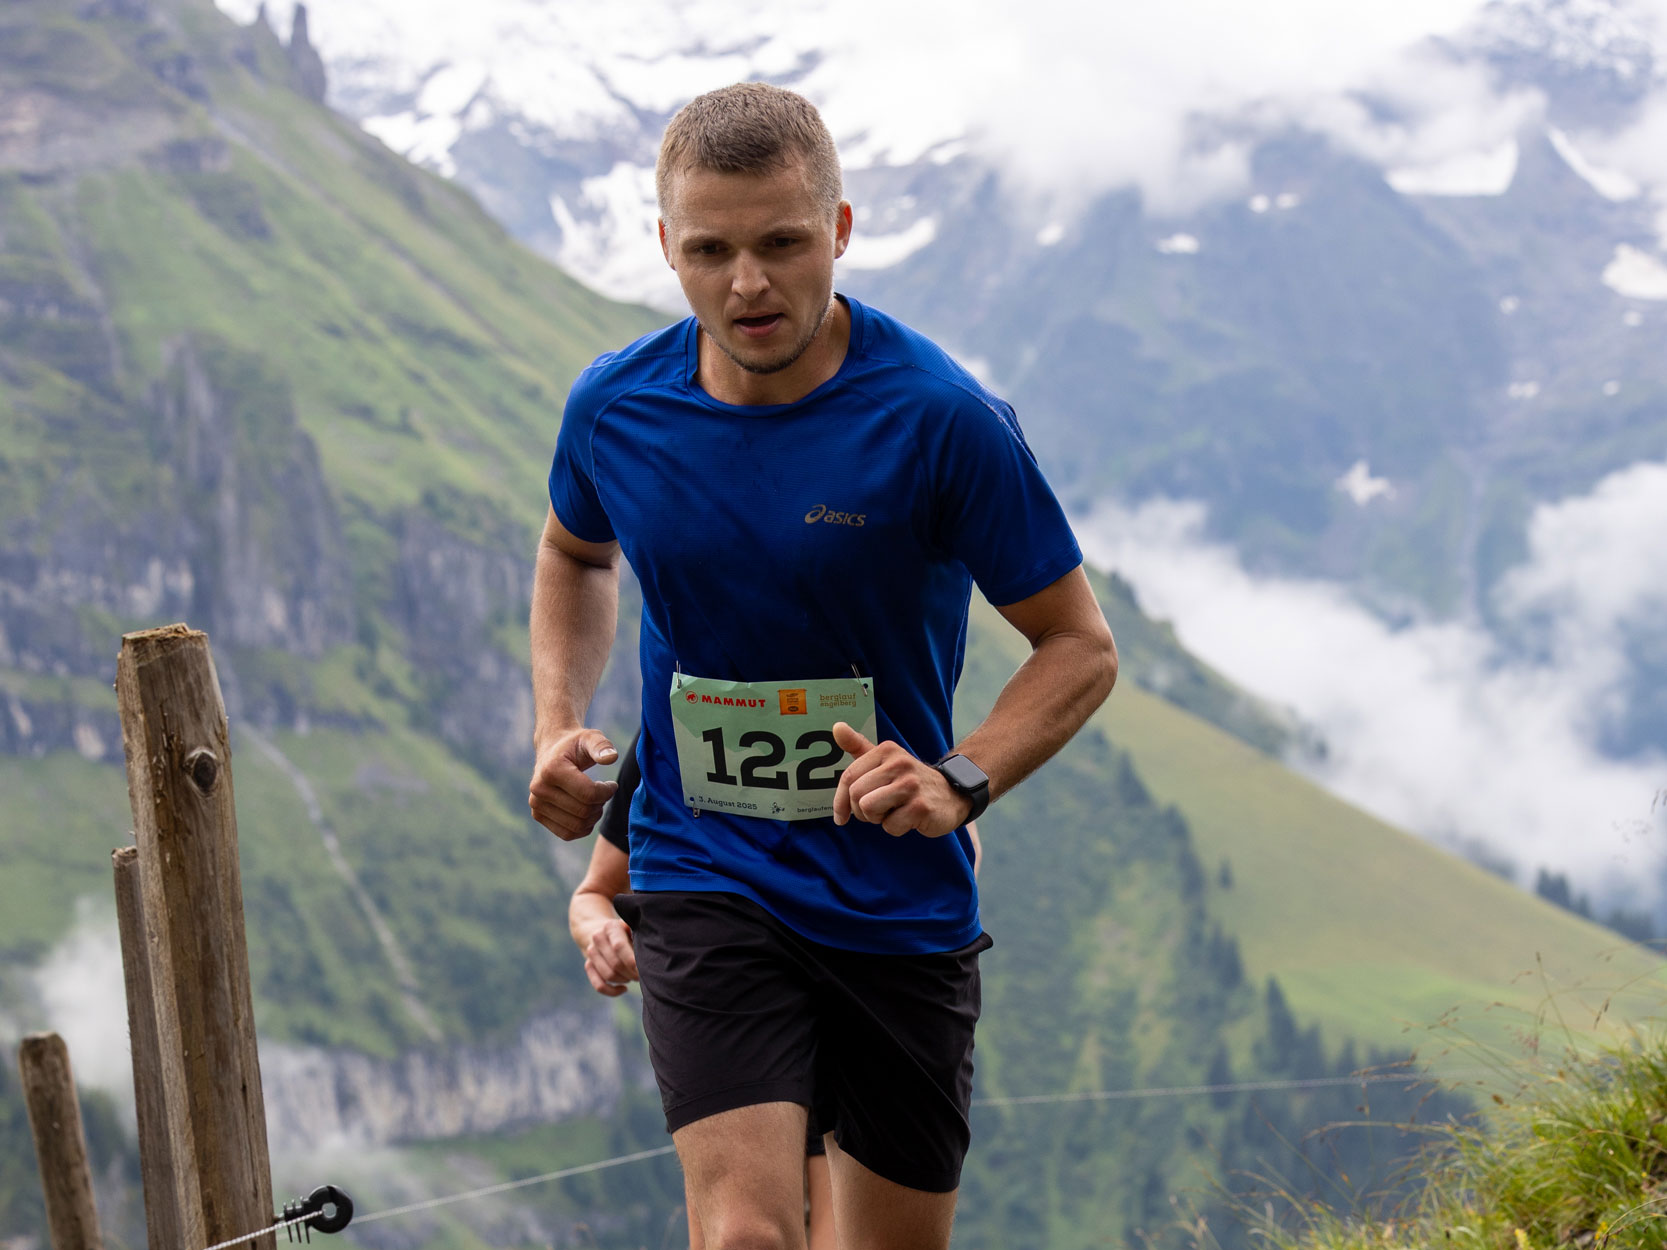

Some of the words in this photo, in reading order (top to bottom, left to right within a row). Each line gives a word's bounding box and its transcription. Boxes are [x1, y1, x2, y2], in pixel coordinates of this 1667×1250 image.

[823, 509, 867, 527] asics
[701, 694, 766, 708] MAMMUT
[819, 692, 856, 702] berglauf
[819, 700, 857, 709] engelberg
[702, 727, 845, 790] 122
[707, 797, 735, 807] August
[736, 801, 758, 810] 2025
[797, 805, 834, 813] berglaufen
